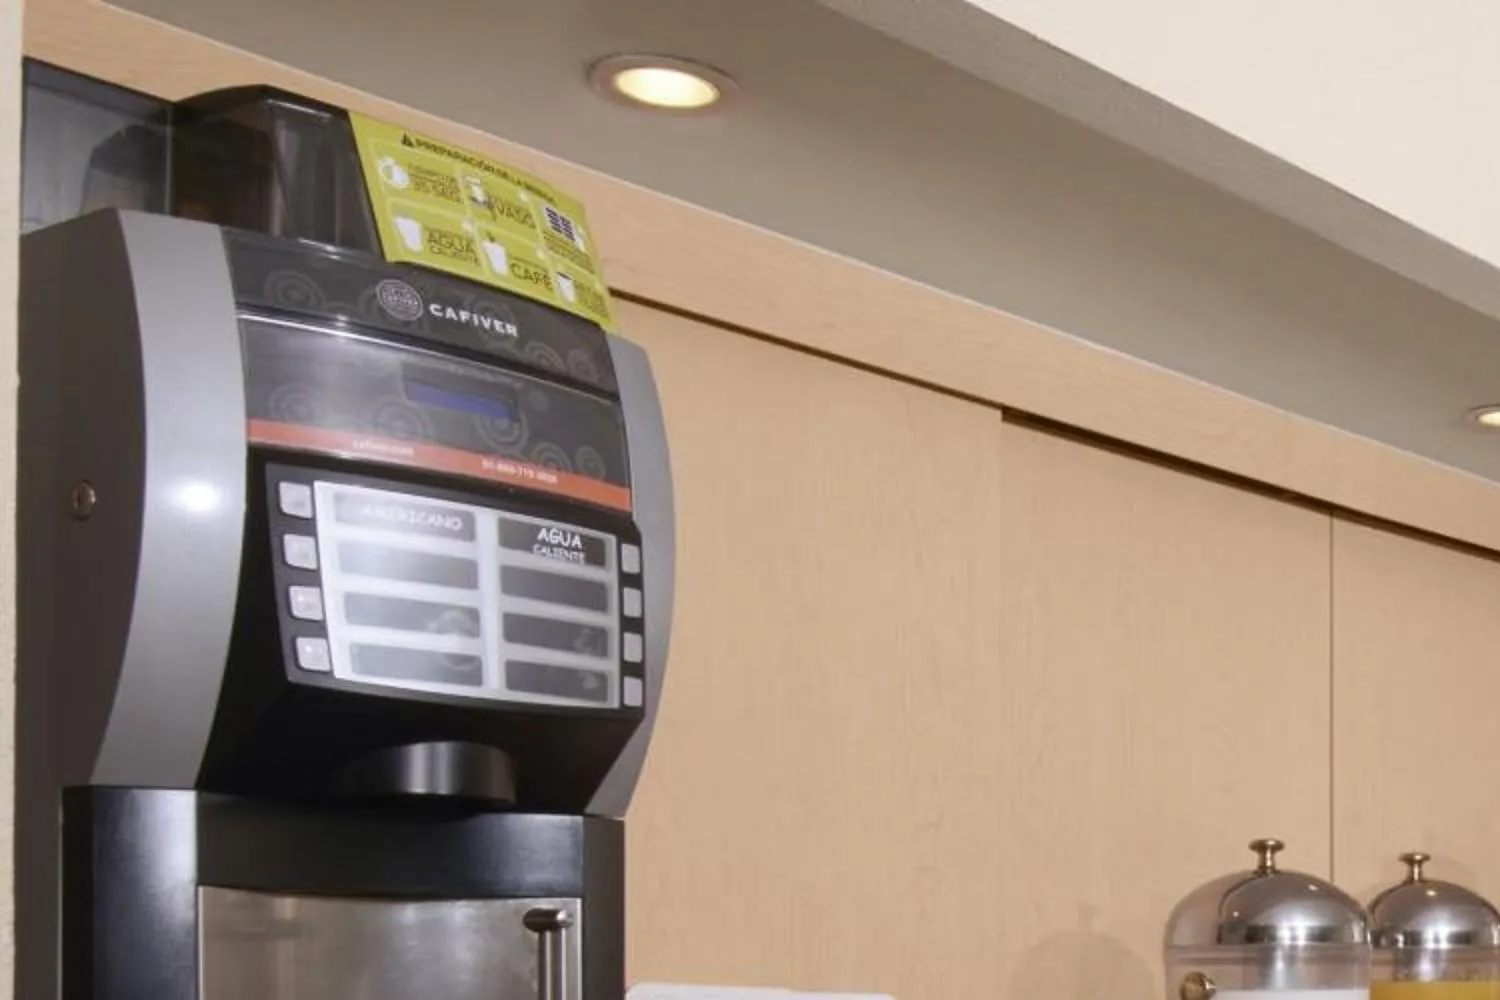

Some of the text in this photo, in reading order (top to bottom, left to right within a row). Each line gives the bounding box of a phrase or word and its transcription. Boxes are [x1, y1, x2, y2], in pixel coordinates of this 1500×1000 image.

[429, 303, 518, 337] CAFIVER
[362, 505, 462, 531] AMERICANO
[537, 527, 582, 549] AGUA
[533, 542, 585, 565] CALIENTE
